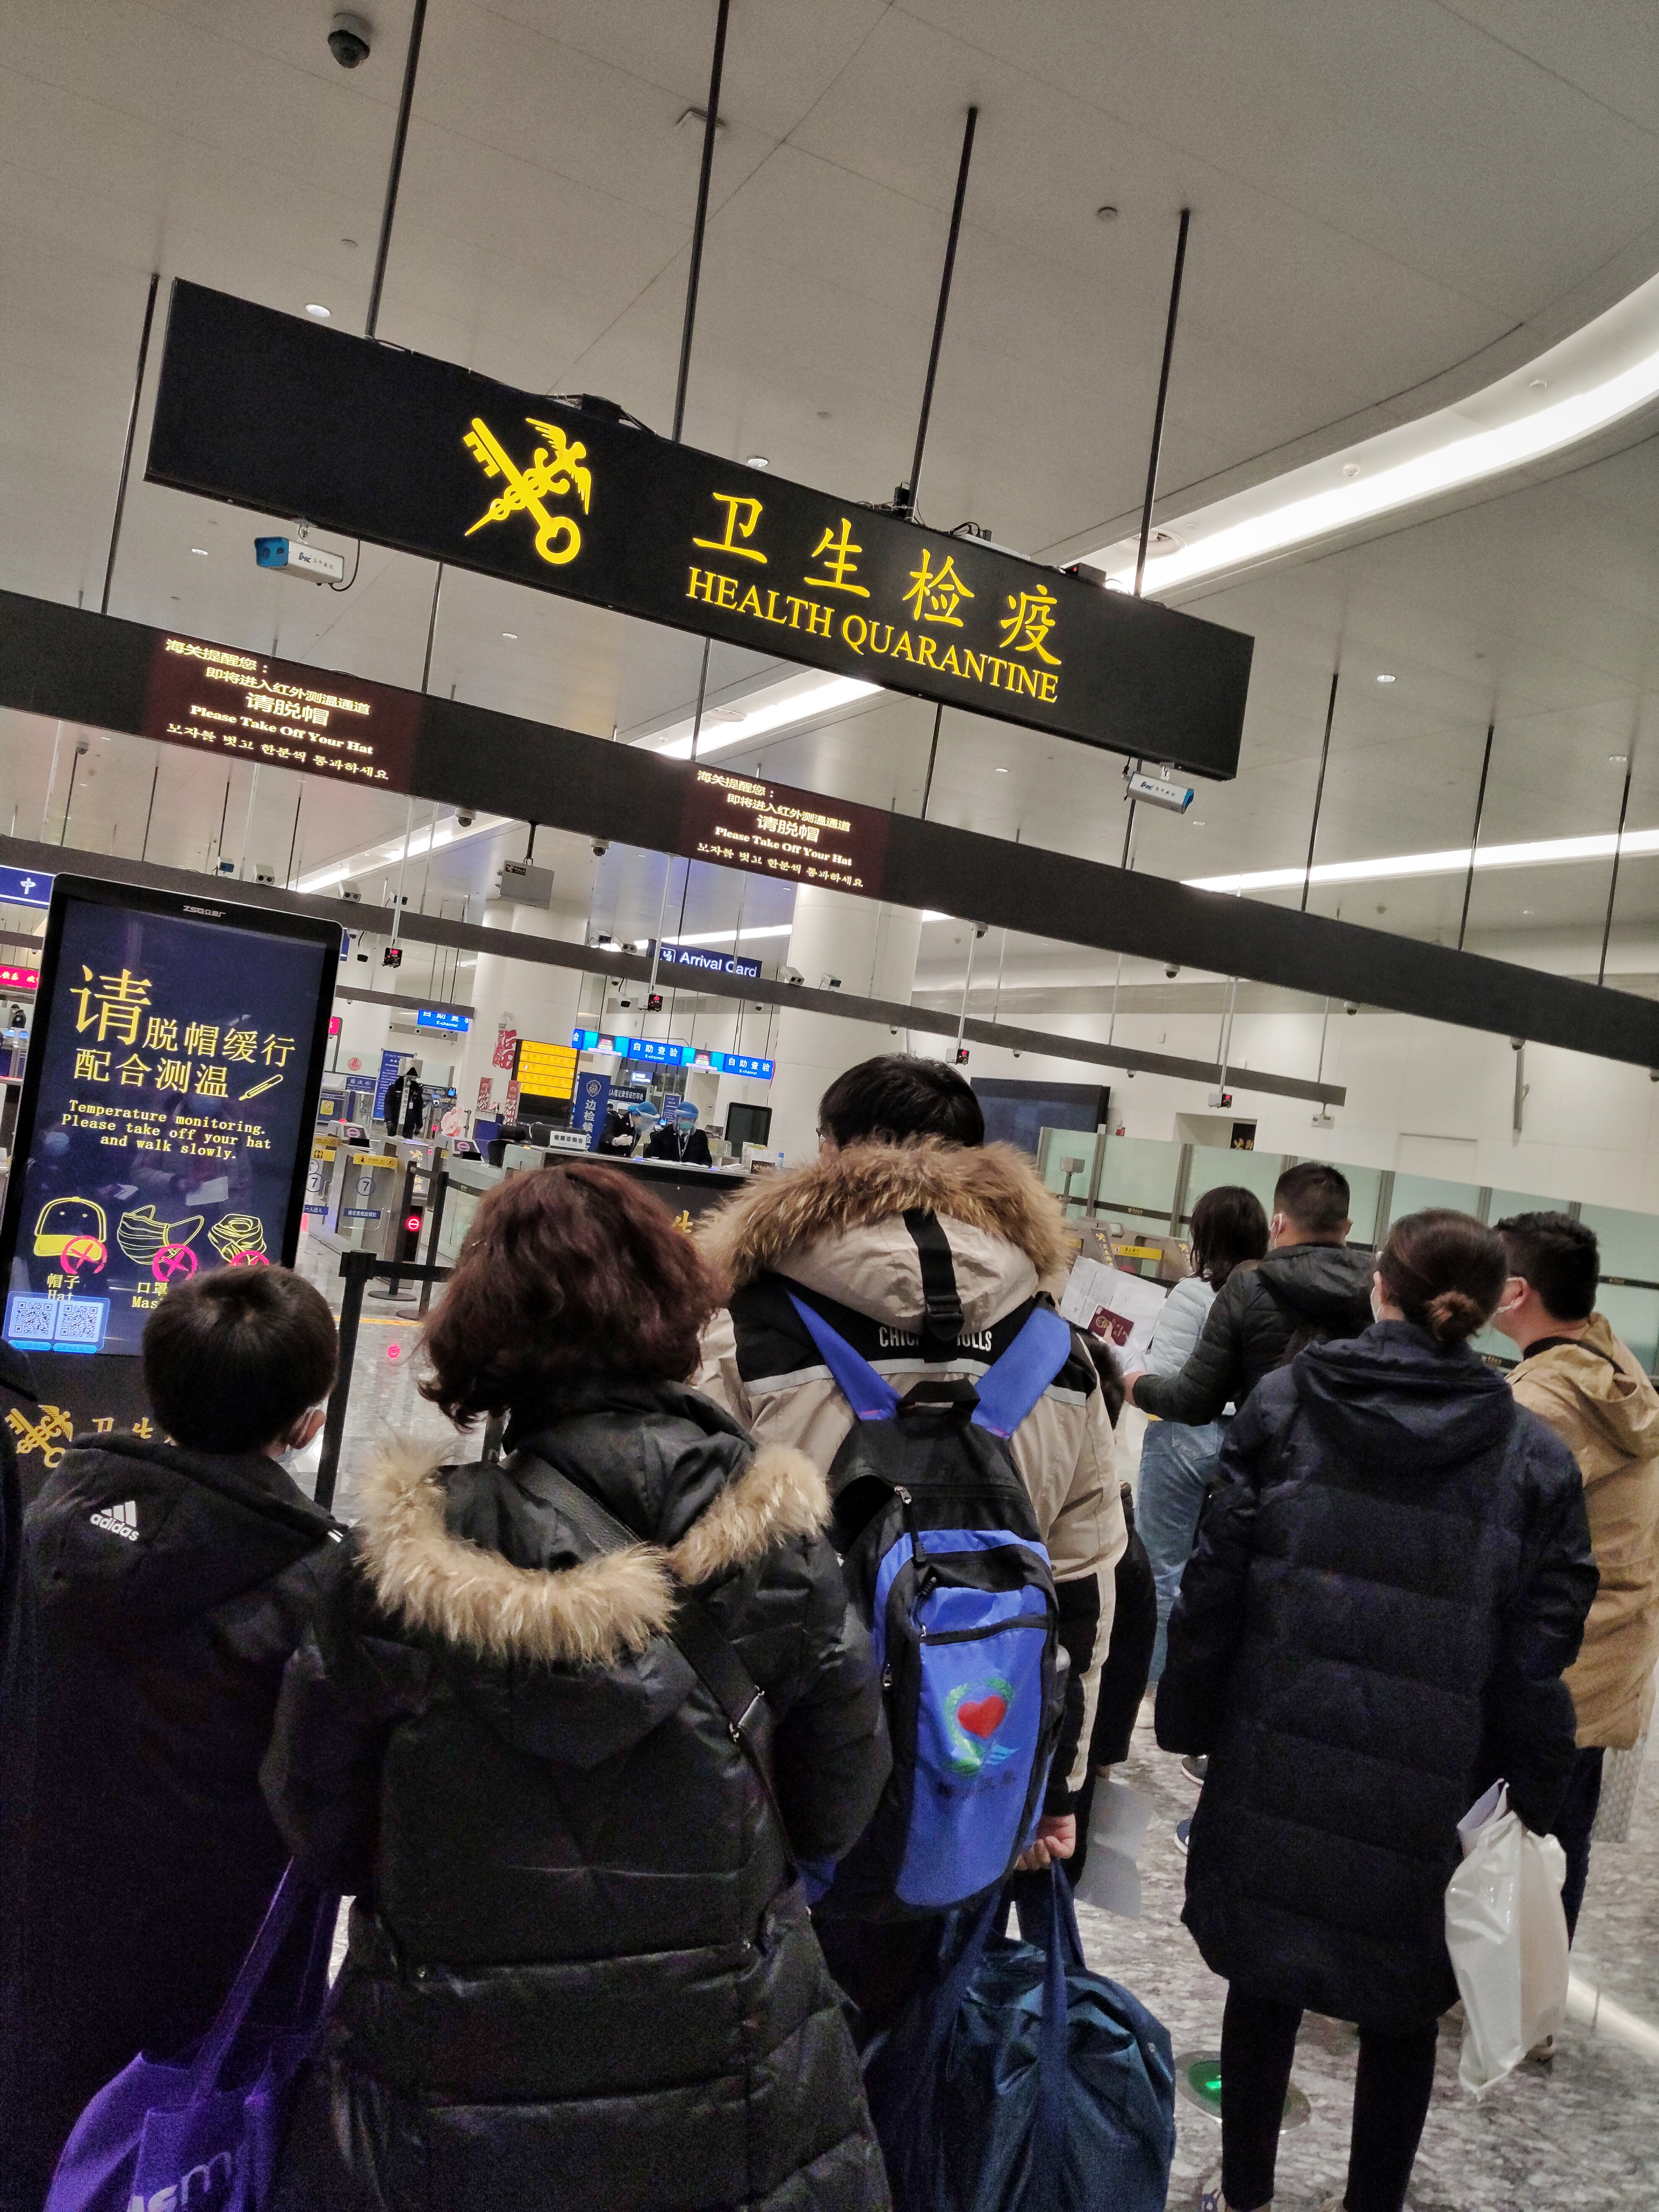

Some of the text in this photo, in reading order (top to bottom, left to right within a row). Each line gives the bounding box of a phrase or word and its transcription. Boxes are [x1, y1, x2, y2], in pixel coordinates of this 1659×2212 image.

[693, 492, 1062, 665] 卫生检疫
[686, 567, 1059, 703] HEALTH QUARANTINE
[205, 667, 370, 715] 即将进入红外测温通道
[246, 692, 330, 726] 请脱帽
[190, 705, 374, 755] Please Take Off Your Hat
[166, 723, 389, 780] 모자를 벗고 한분씩 통과하세요
[727, 794, 851, 832] 即将进入红外测温通道
[757, 815, 820, 843] 请脱帽
[715, 826, 852, 866] Please Take Off Your Hat
[680, 951, 757, 977] Arrival Card
[633, 1042, 678, 1057] 自助查验
[73, 1048, 229, 1099] 配合测温
[728, 1058, 770, 1072] 自助查验
[609, 1089, 644, 1100] 入境记录凭证打印处
[69, 1099, 266, 1135] Temperature monitoring.
[61, 1114, 271, 1149] Please take off your hat
[100, 1134, 237, 1159] and walk slowly.
[311, 1177, 318, 1188] 7
[363, 1181, 370, 1192] 7
[47, 1273, 80, 1289] 帽子
[137, 1282, 168, 1297] 口罩
[48, 1289, 73, 1301] Hat
[131, 1296, 163, 1309] Mas
[879, 1327, 992, 1351] CHIC ULLS
[90, 1514, 139, 1541] adidas
